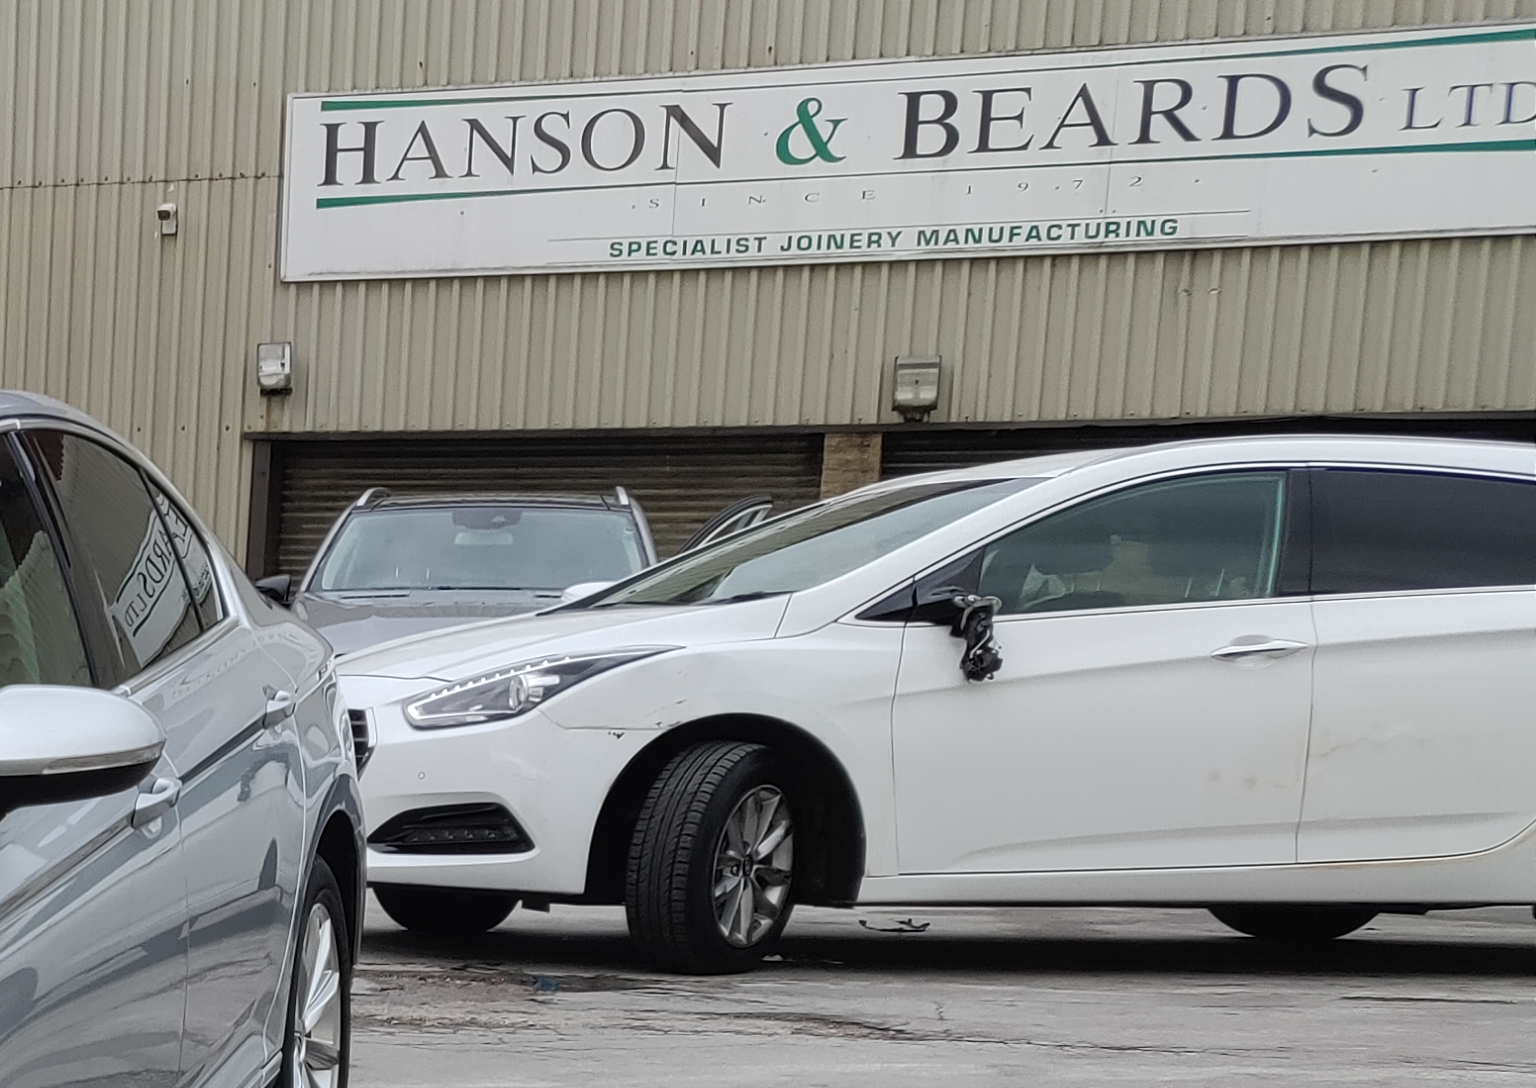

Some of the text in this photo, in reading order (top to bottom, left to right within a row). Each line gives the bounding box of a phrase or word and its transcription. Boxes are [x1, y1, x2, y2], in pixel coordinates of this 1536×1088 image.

[316, 63, 1536, 188] HANSON & BEARDS LTD
[609, 217, 1179, 258] SPECIALIST JOINERY MANUFACTURING
